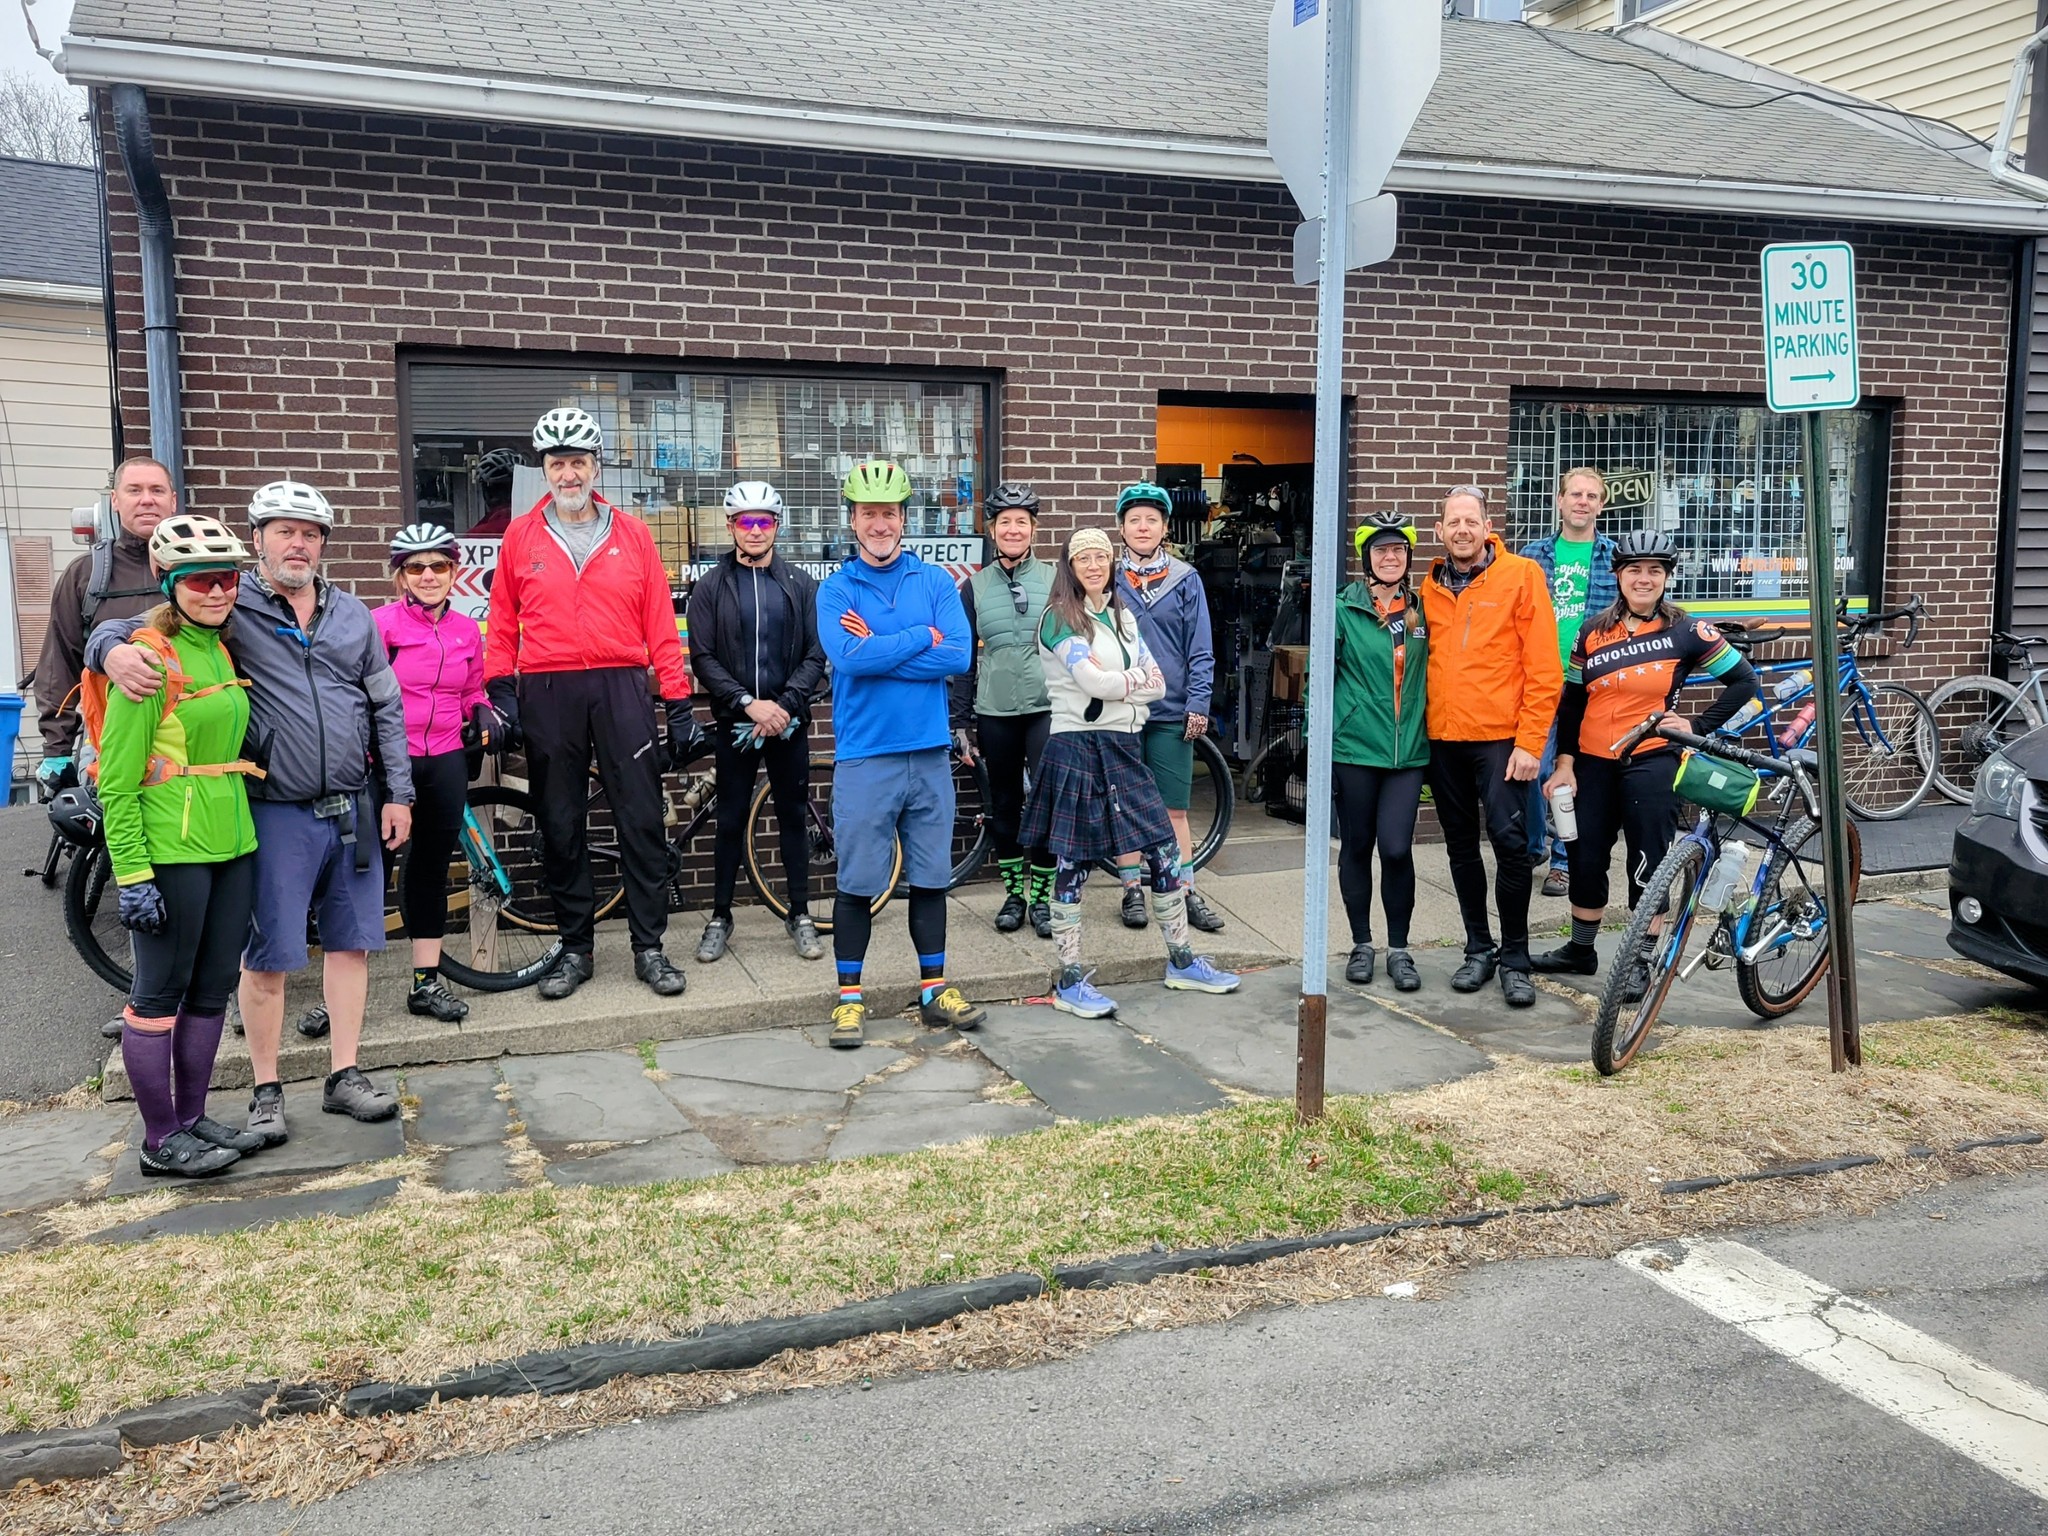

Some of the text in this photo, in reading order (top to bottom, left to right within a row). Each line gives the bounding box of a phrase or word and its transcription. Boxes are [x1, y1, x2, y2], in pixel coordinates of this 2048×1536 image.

[1790, 260, 1828, 291] 30
[1774, 299, 1846, 326] MINUTE
[1774, 332, 1849, 360] PARKING
[1586, 636, 1674, 670] REVOLUTION
